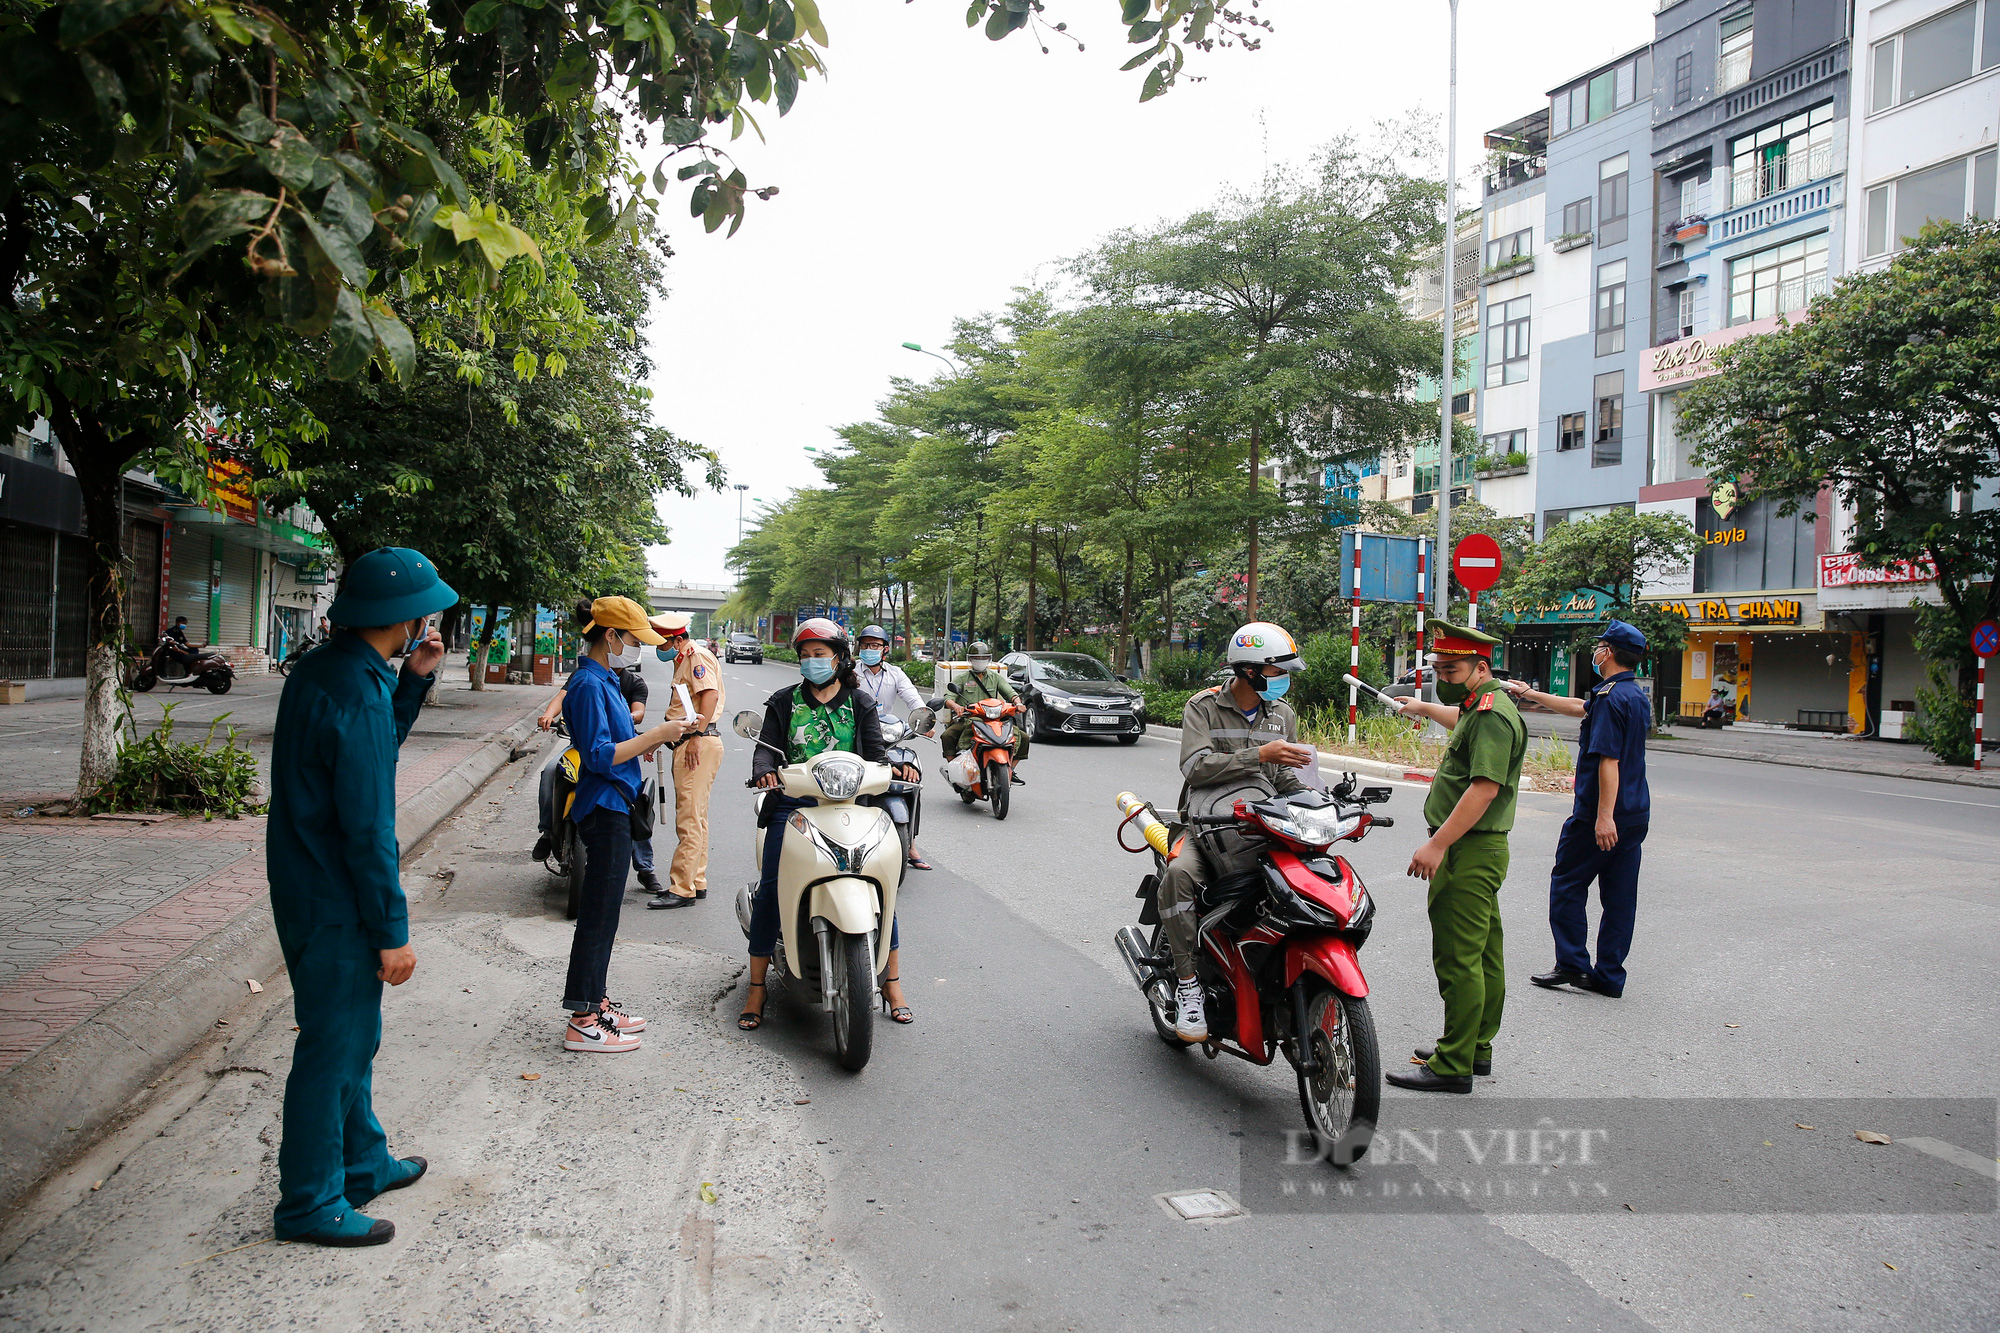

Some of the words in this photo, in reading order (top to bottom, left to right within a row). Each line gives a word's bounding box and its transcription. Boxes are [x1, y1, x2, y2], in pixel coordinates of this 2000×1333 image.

[1651, 346, 1688, 372] Libé
[1704, 527, 1747, 546] Layla
[1565, 594, 1597, 612] Anh
[1696, 598, 1730, 620] TRÀ
[1738, 599, 1801, 620] CHANH
[1267, 723, 1281, 732] TIN
[1268, 915, 1290, 928] HONDA
